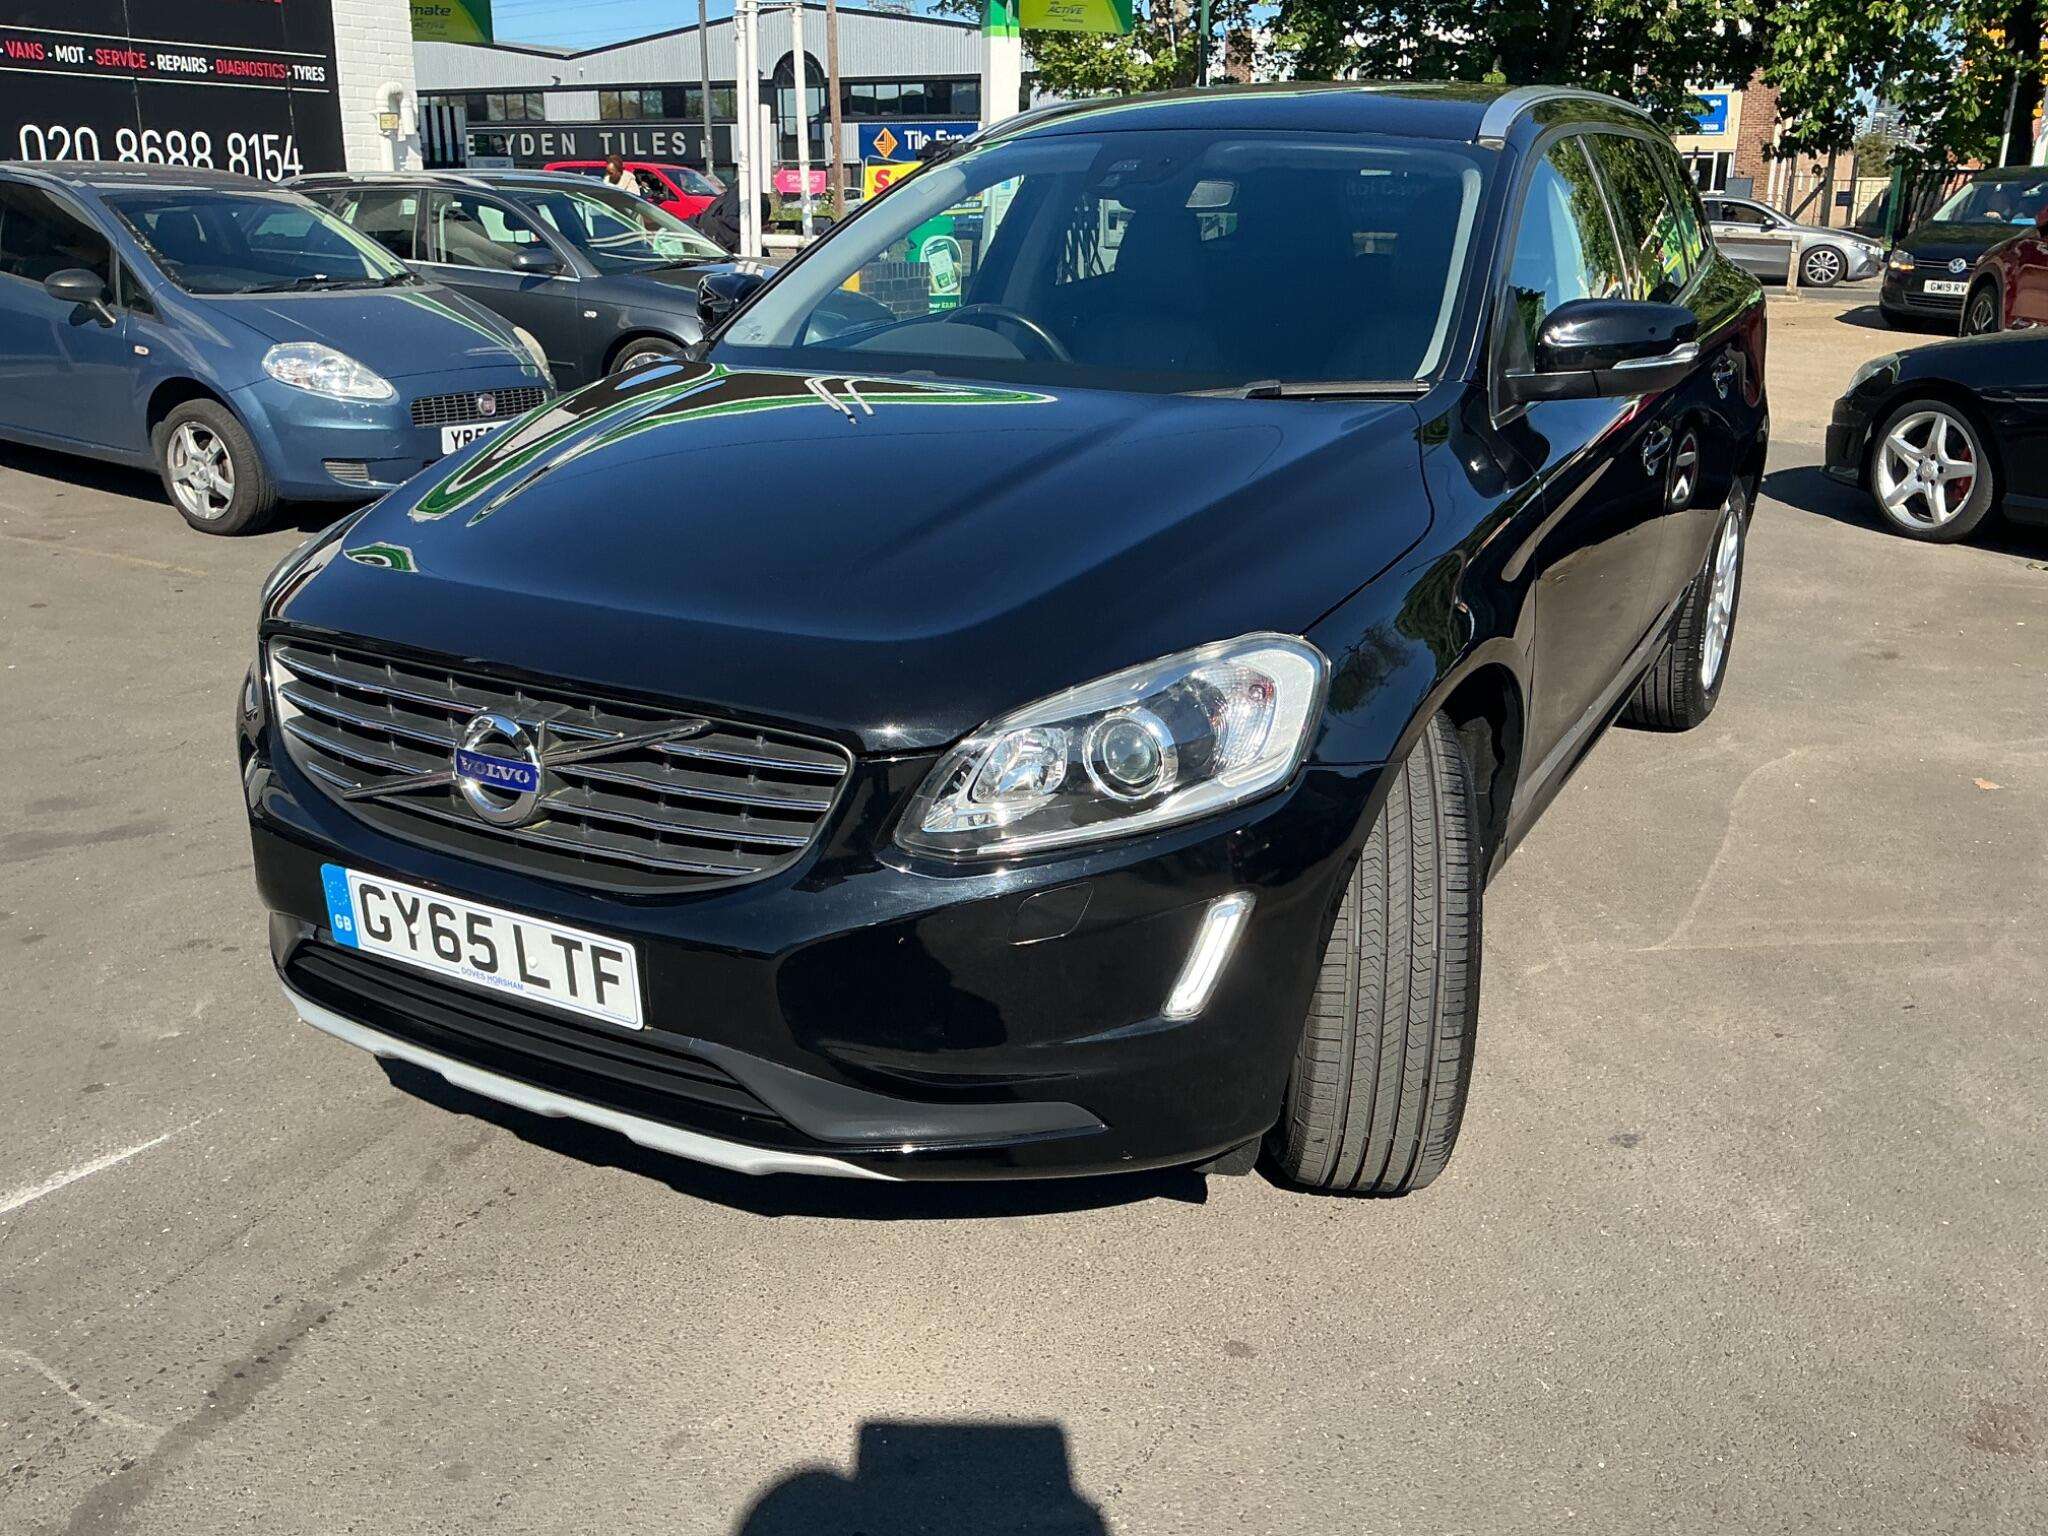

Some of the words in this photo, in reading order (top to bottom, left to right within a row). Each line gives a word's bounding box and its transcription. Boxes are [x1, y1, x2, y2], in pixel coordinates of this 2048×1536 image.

[1046, 6, 1085, 15] ACTIVE
[5, 40, 44, 60] VANS
[54, 44, 85, 64] MOT
[95, 48, 147, 69] SERVICE
[156, 54, 208, 73] REPAIRS
[215, 59, 286, 79] DIAGNOSTICS
[292, 64, 325, 82] TYRES
[600, 131, 686, 156] TILES
[903, 129, 931, 150] Tile
[19, 124, 100, 161] 020
[115, 127, 214, 169] 8688
[227, 132, 304, 183] 8154
[460, 755, 530, 784] VOLVO
[334, 913, 353, 932] GB
[358, 882, 500, 974] GY65
[512, 923, 624, 1006] LTF
